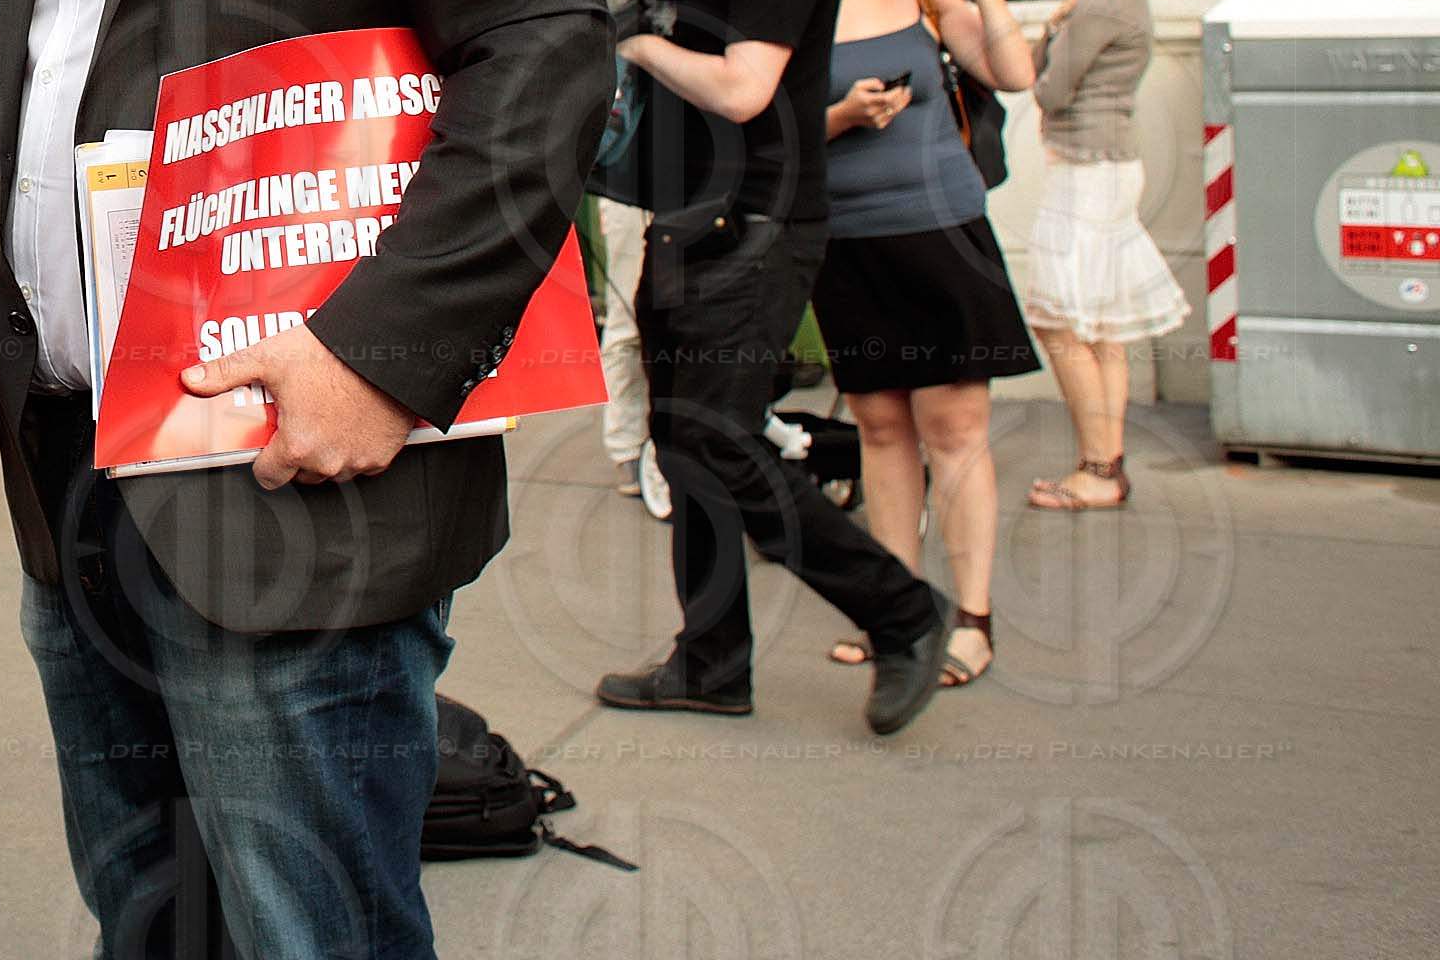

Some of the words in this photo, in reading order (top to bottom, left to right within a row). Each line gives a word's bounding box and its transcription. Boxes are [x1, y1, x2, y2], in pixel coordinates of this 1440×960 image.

[162, 80, 346, 165] MASSENLAGER
[352, 73, 443, 121] ABSC
[158, 170, 341, 251] FLÜCHTLINGE
[221, 214, 398, 275] UNTERBR
